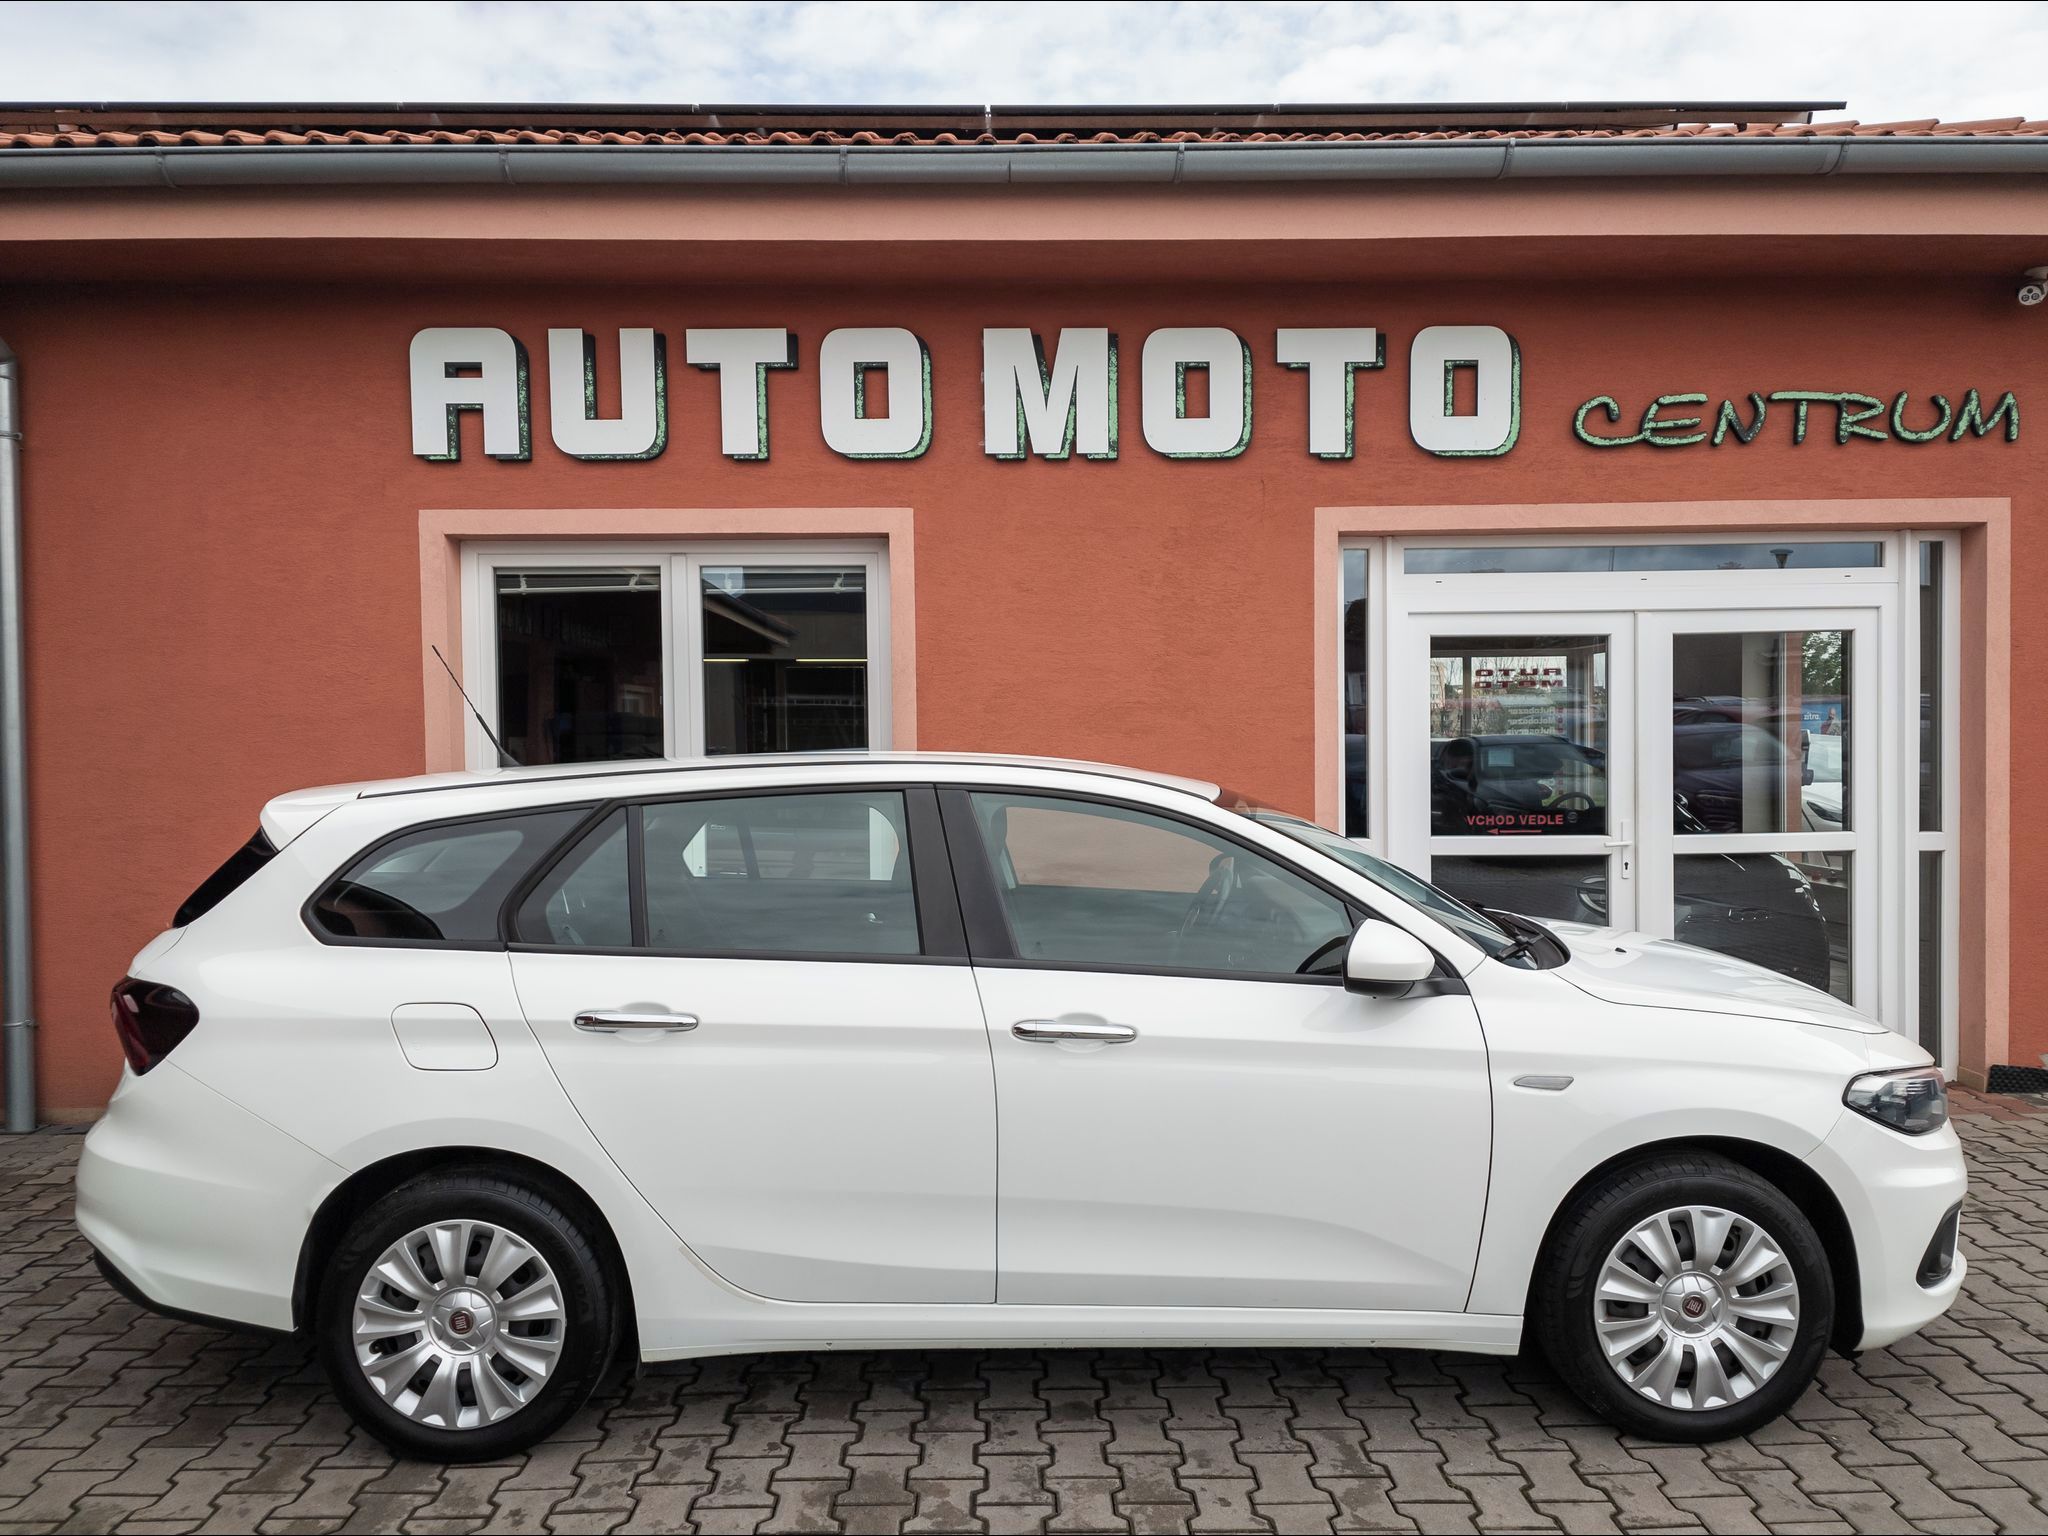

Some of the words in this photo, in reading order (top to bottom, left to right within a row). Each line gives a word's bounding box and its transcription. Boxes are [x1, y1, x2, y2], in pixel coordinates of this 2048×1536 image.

[409, 327, 931, 460] AUTO
[983, 325, 1521, 459] MOTO
[1573, 388, 2020, 447] CENTRUM
[1466, 815, 1515, 826] VCHOD
[1519, 814, 1564, 825] VEDLE
